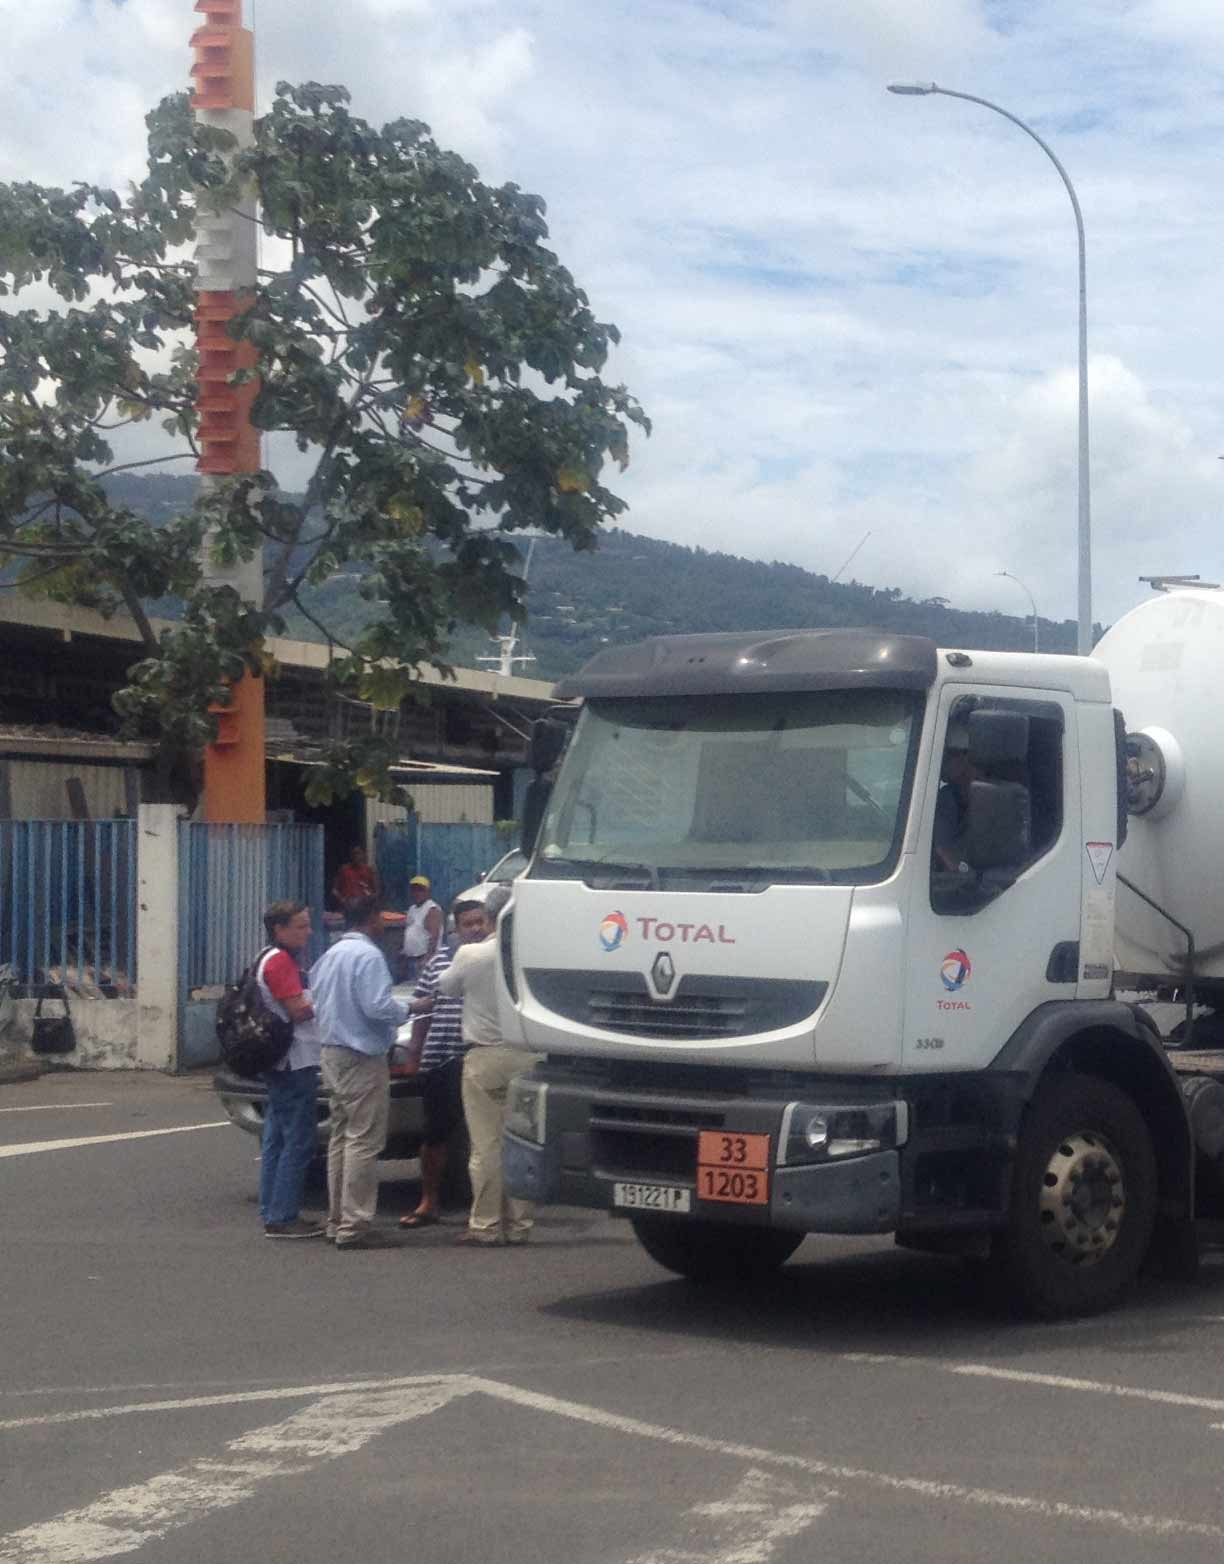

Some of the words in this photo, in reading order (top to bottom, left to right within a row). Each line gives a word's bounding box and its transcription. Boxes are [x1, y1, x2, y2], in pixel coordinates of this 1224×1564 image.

[636, 917, 736, 944] TOTAL
[937, 1000, 971, 1010] TOTAL
[720, 1137, 747, 1163] 33
[705, 1170, 758, 1199] 1203
